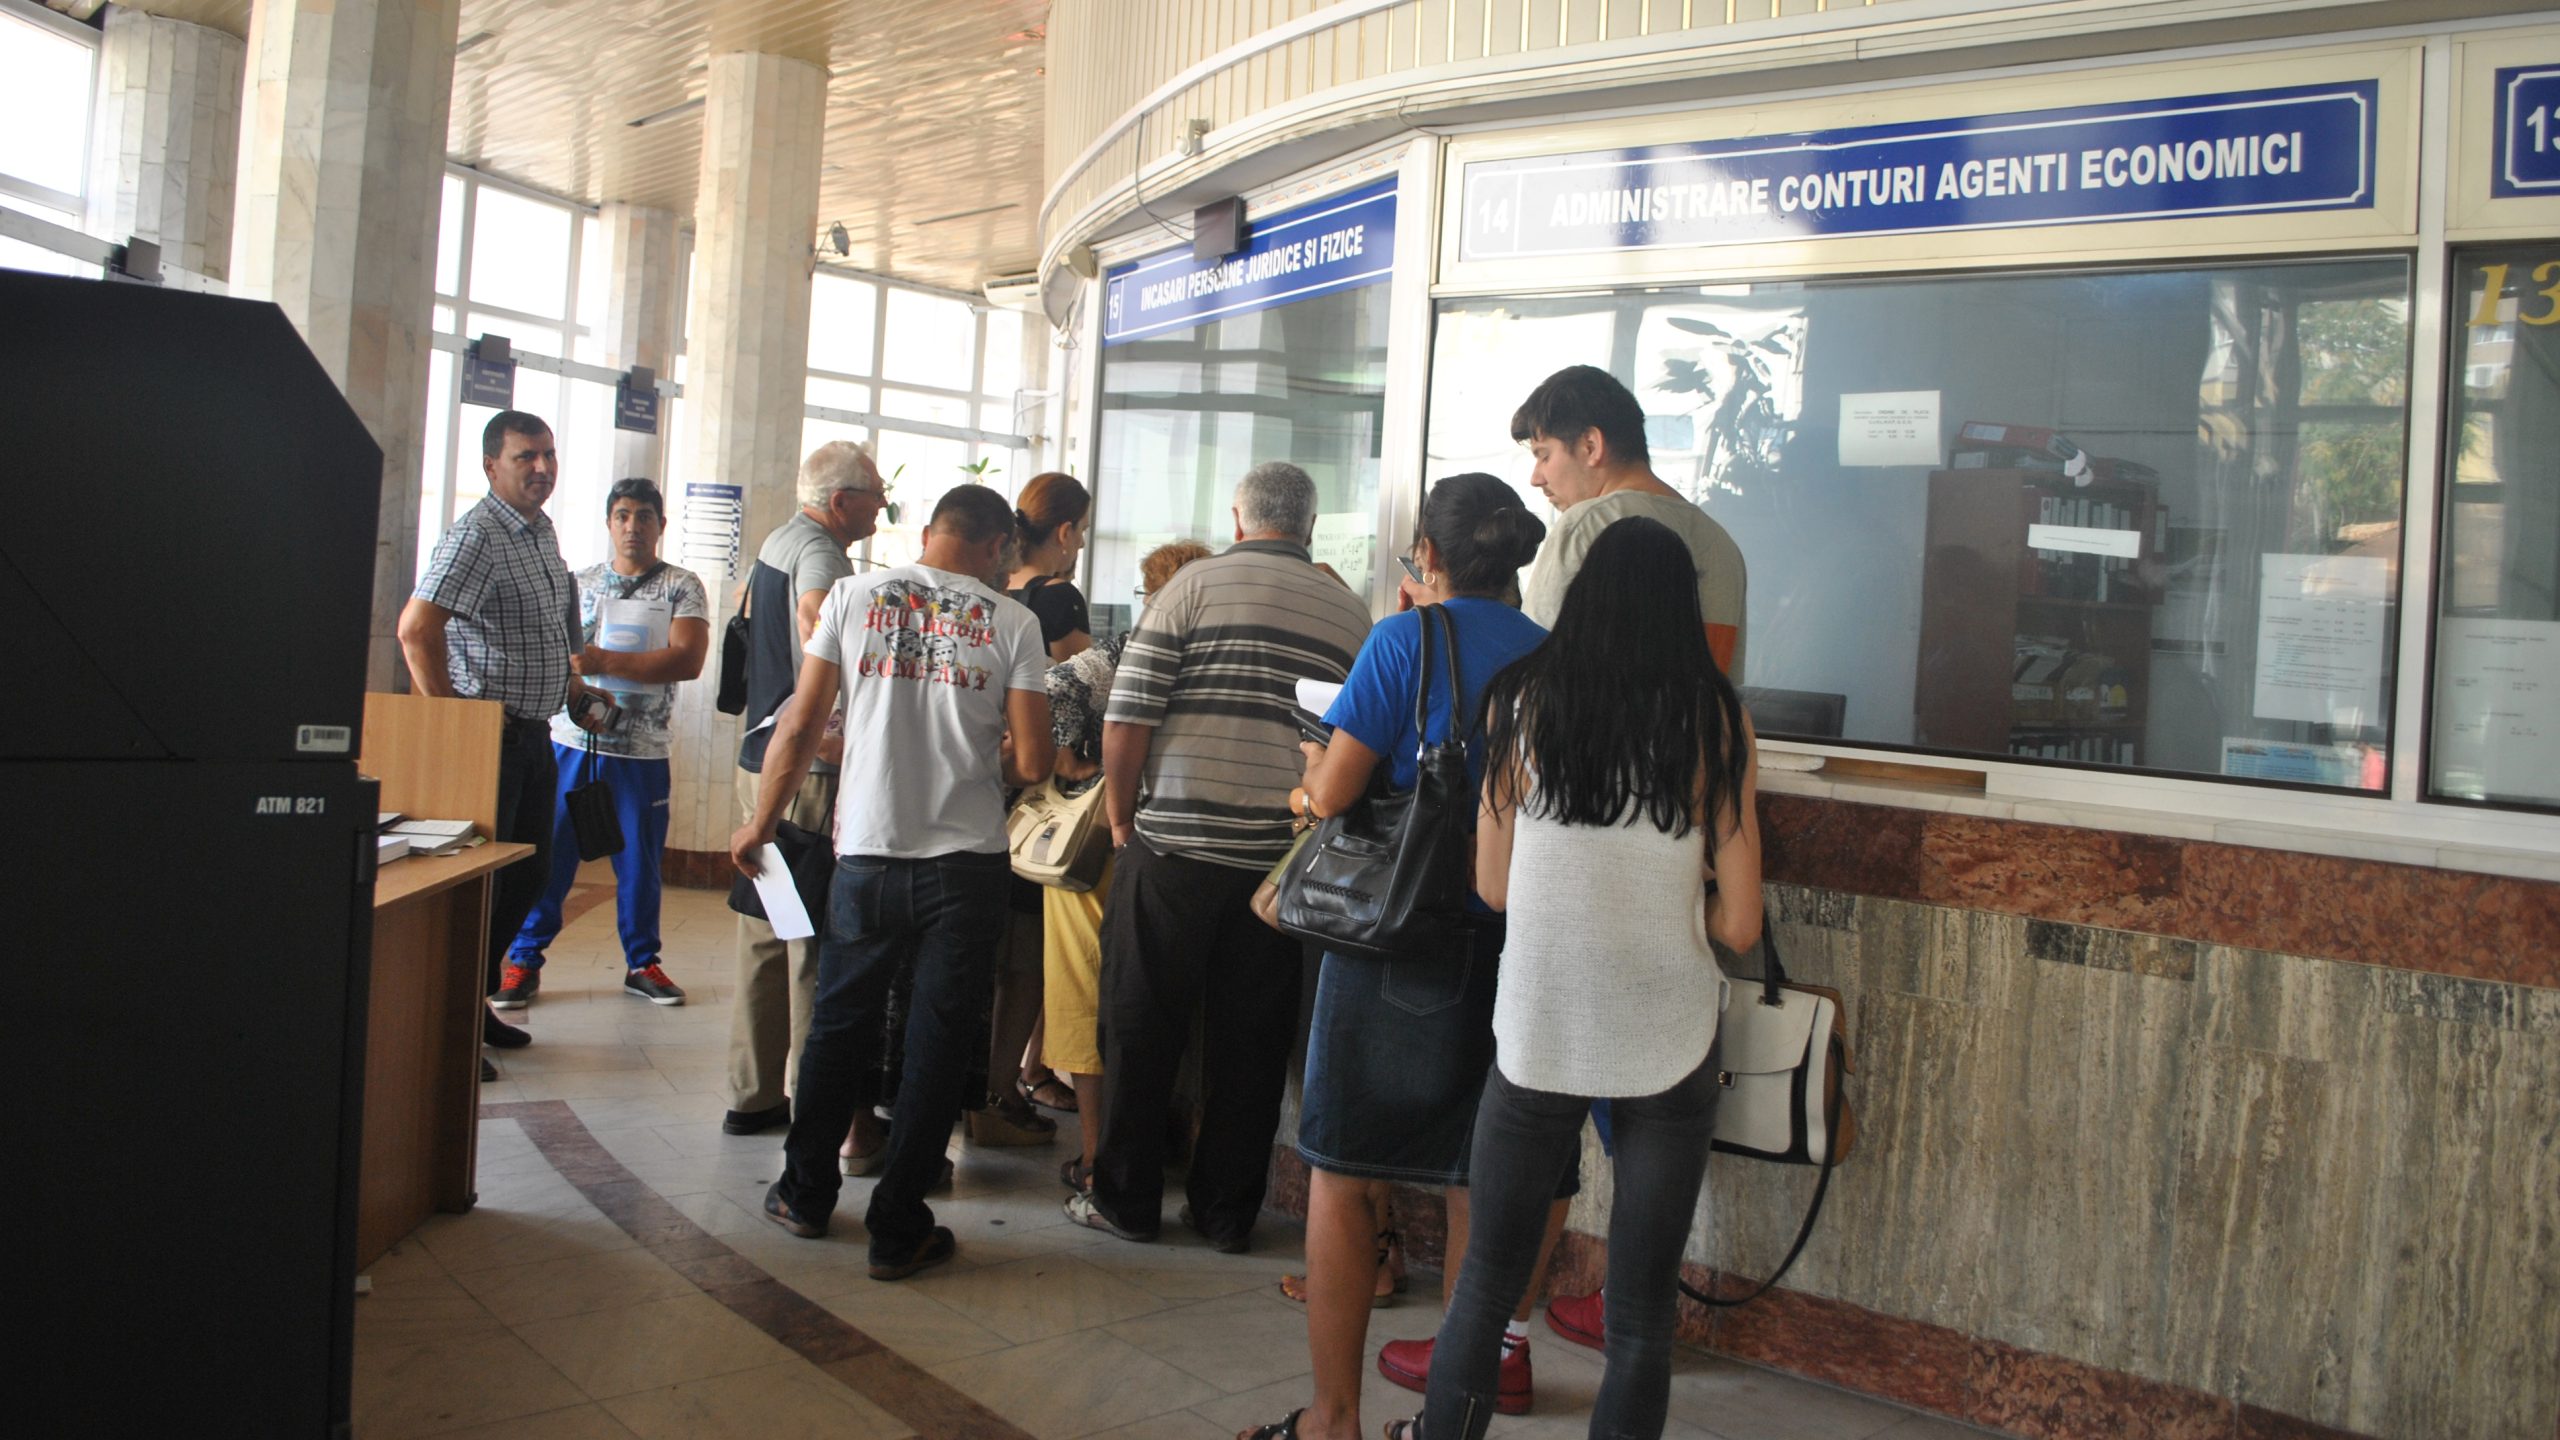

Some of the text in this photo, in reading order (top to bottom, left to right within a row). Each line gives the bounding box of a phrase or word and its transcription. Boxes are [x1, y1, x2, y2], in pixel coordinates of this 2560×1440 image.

[1549, 132, 2302, 229] ADMINISTRARE CONTURI AGENTI ECONOMICI
[1478, 199, 1509, 235] 14
[1140, 276, 1186, 312] INCASARI
[1246, 242, 1302, 284] JURIDICE
[1303, 239, 1317, 268] SI
[1319, 225, 1364, 265] FIZICE
[1108, 293, 1120, 321] 15
[256, 797, 325, 814] ATM 821
